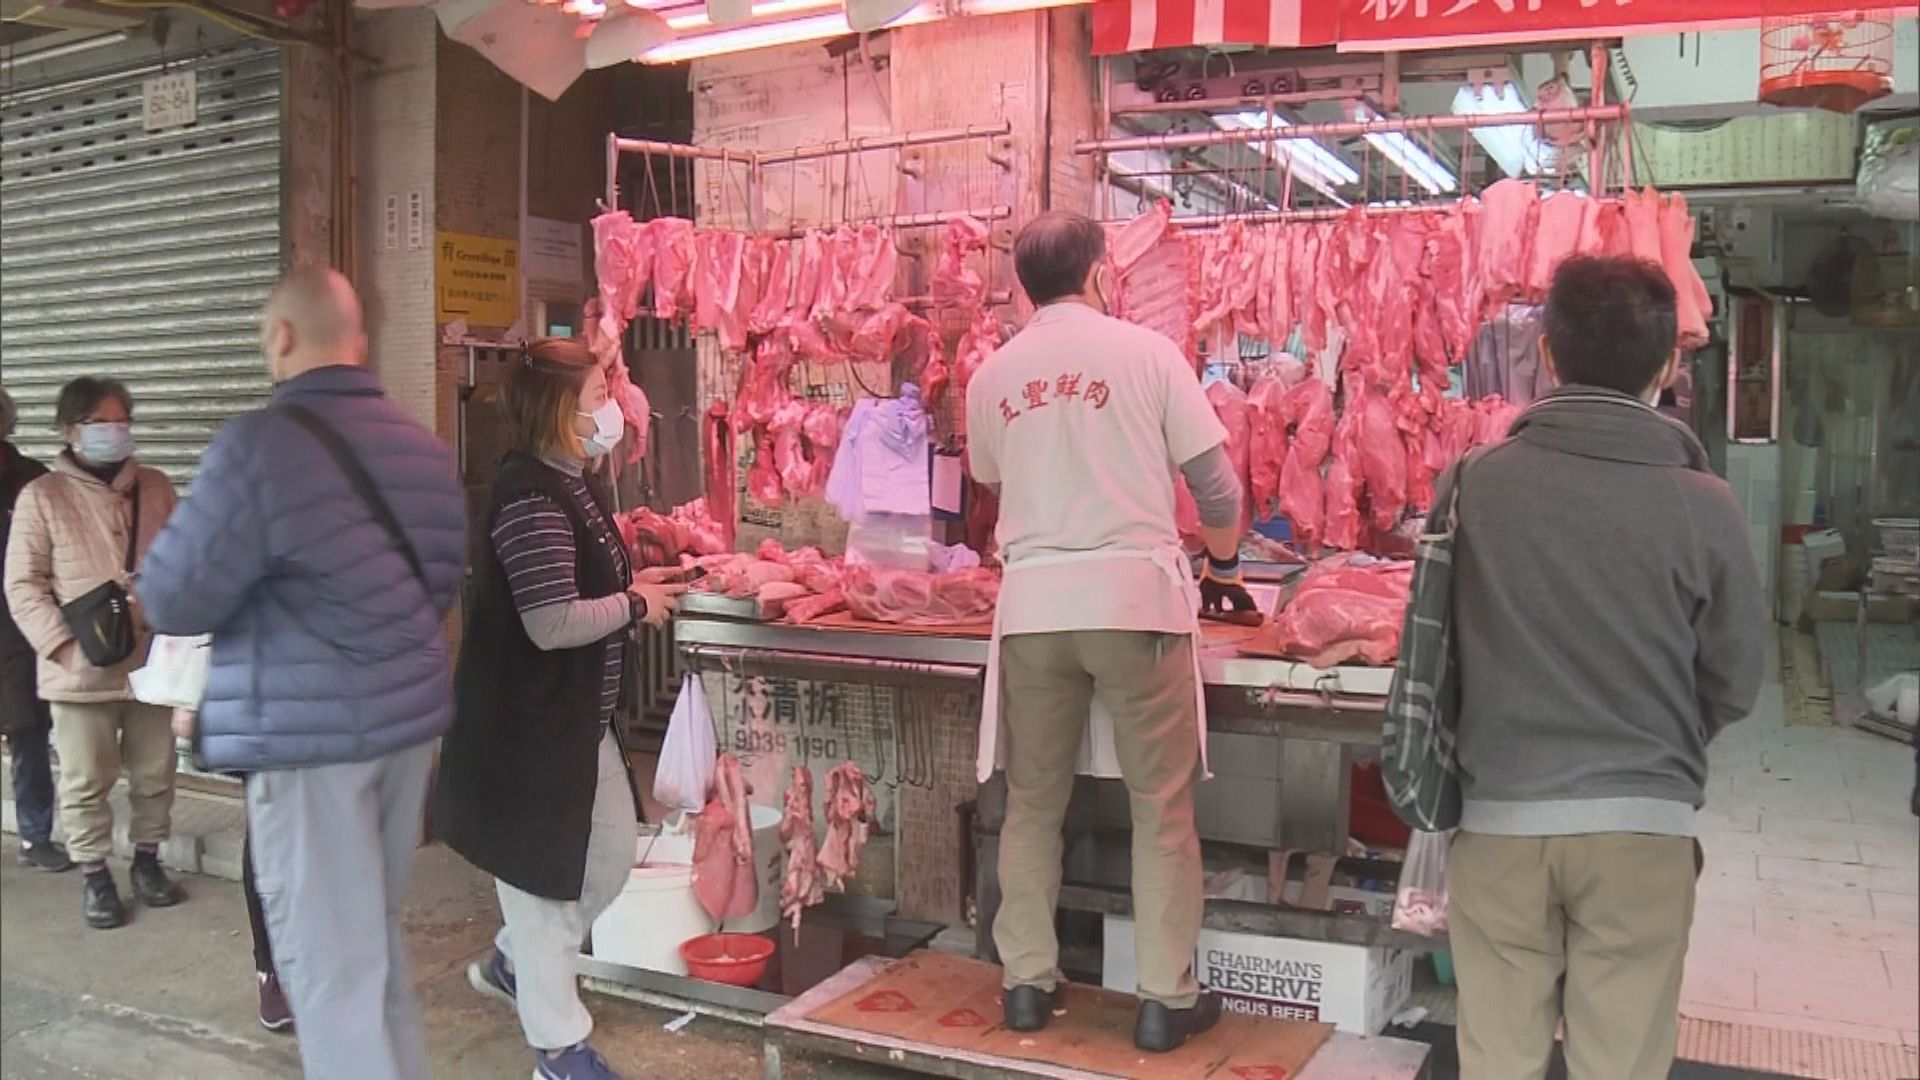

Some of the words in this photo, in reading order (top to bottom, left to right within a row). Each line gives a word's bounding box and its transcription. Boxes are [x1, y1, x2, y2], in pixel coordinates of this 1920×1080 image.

[999, 371, 1110, 427] 五豐鮮肉
[1207, 949, 1323, 980] CHAIRMAN'S
[1207, 966, 1323, 1004] RESERVE
[1221, 996, 1269, 1017] NGUS
